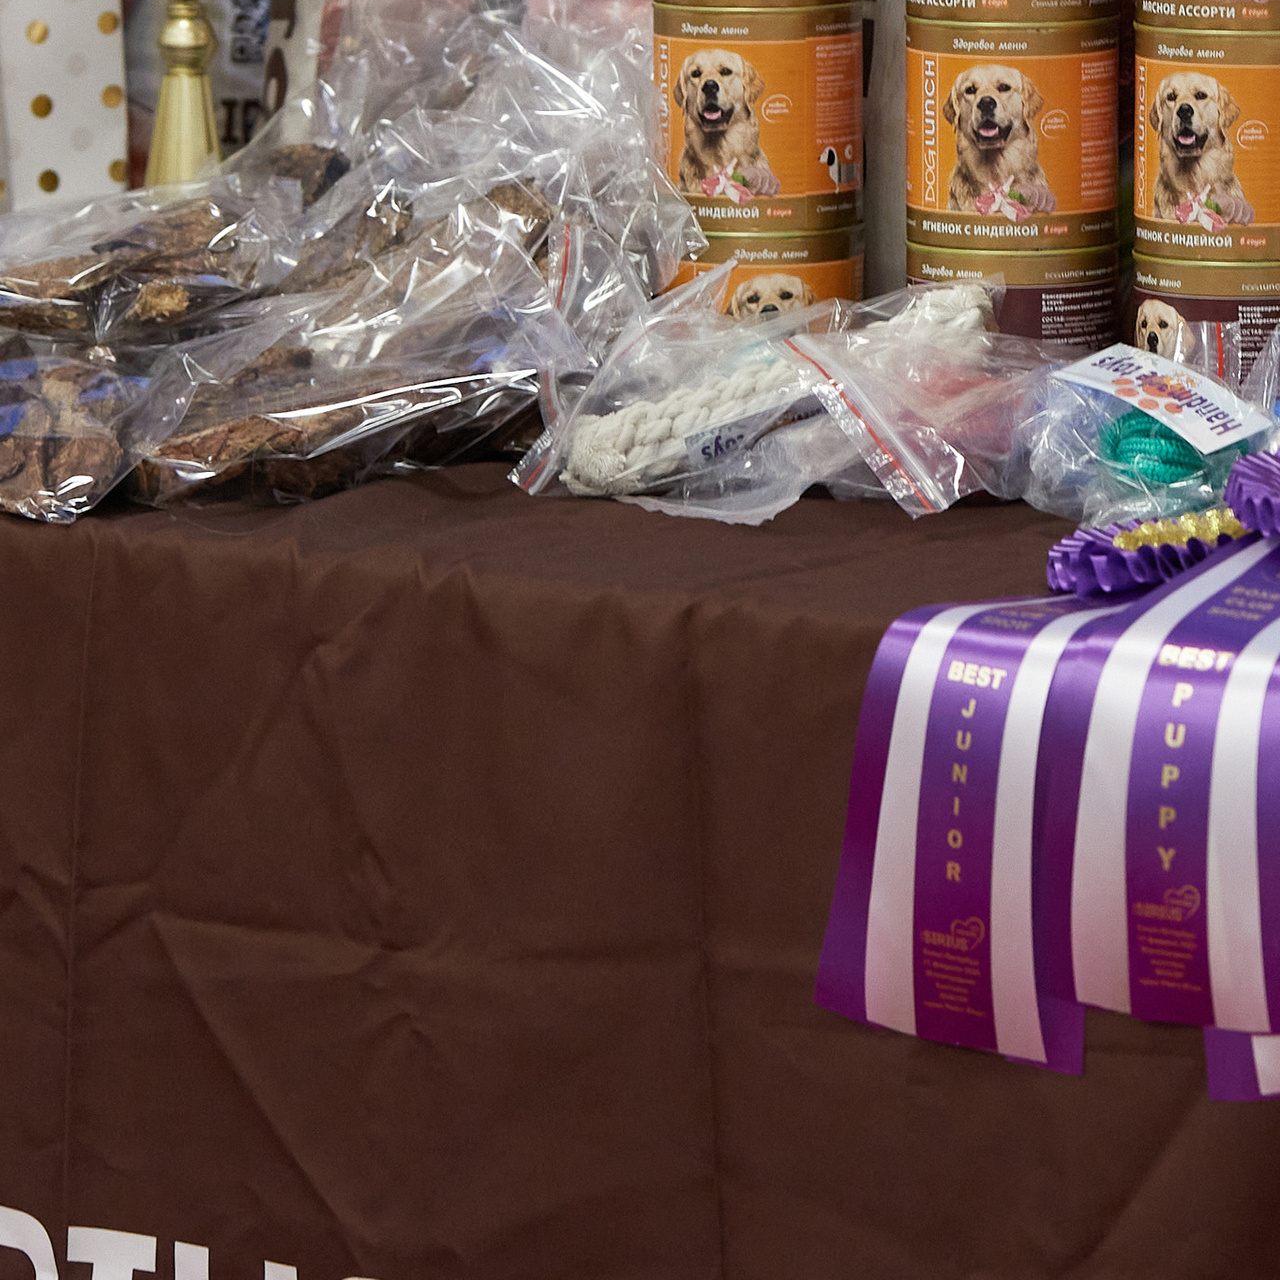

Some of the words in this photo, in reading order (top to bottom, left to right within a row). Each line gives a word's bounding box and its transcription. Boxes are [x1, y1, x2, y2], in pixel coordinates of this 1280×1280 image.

[1142, 0, 1175, 15] МЯСНОЕ
[1179, 3, 1235, 18] АССОРТИ
[699, 207, 758, 219] ИНДЕЙКОЙ
[922, 221, 962, 235] ЯГНЕНОК
[965, 225, 971, 235] С
[974, 224, 1038, 237] ИНДЕЙКОЙ
[1173, 234, 1232, 247] ИНДЕЙКОЙ
[1158, 644, 1234, 672] BEST
[948, 660, 1007, 691] BEST
[1157, 682, 1194, 872] PUPPY
[946, 699, 977, 883] JUNIOR
